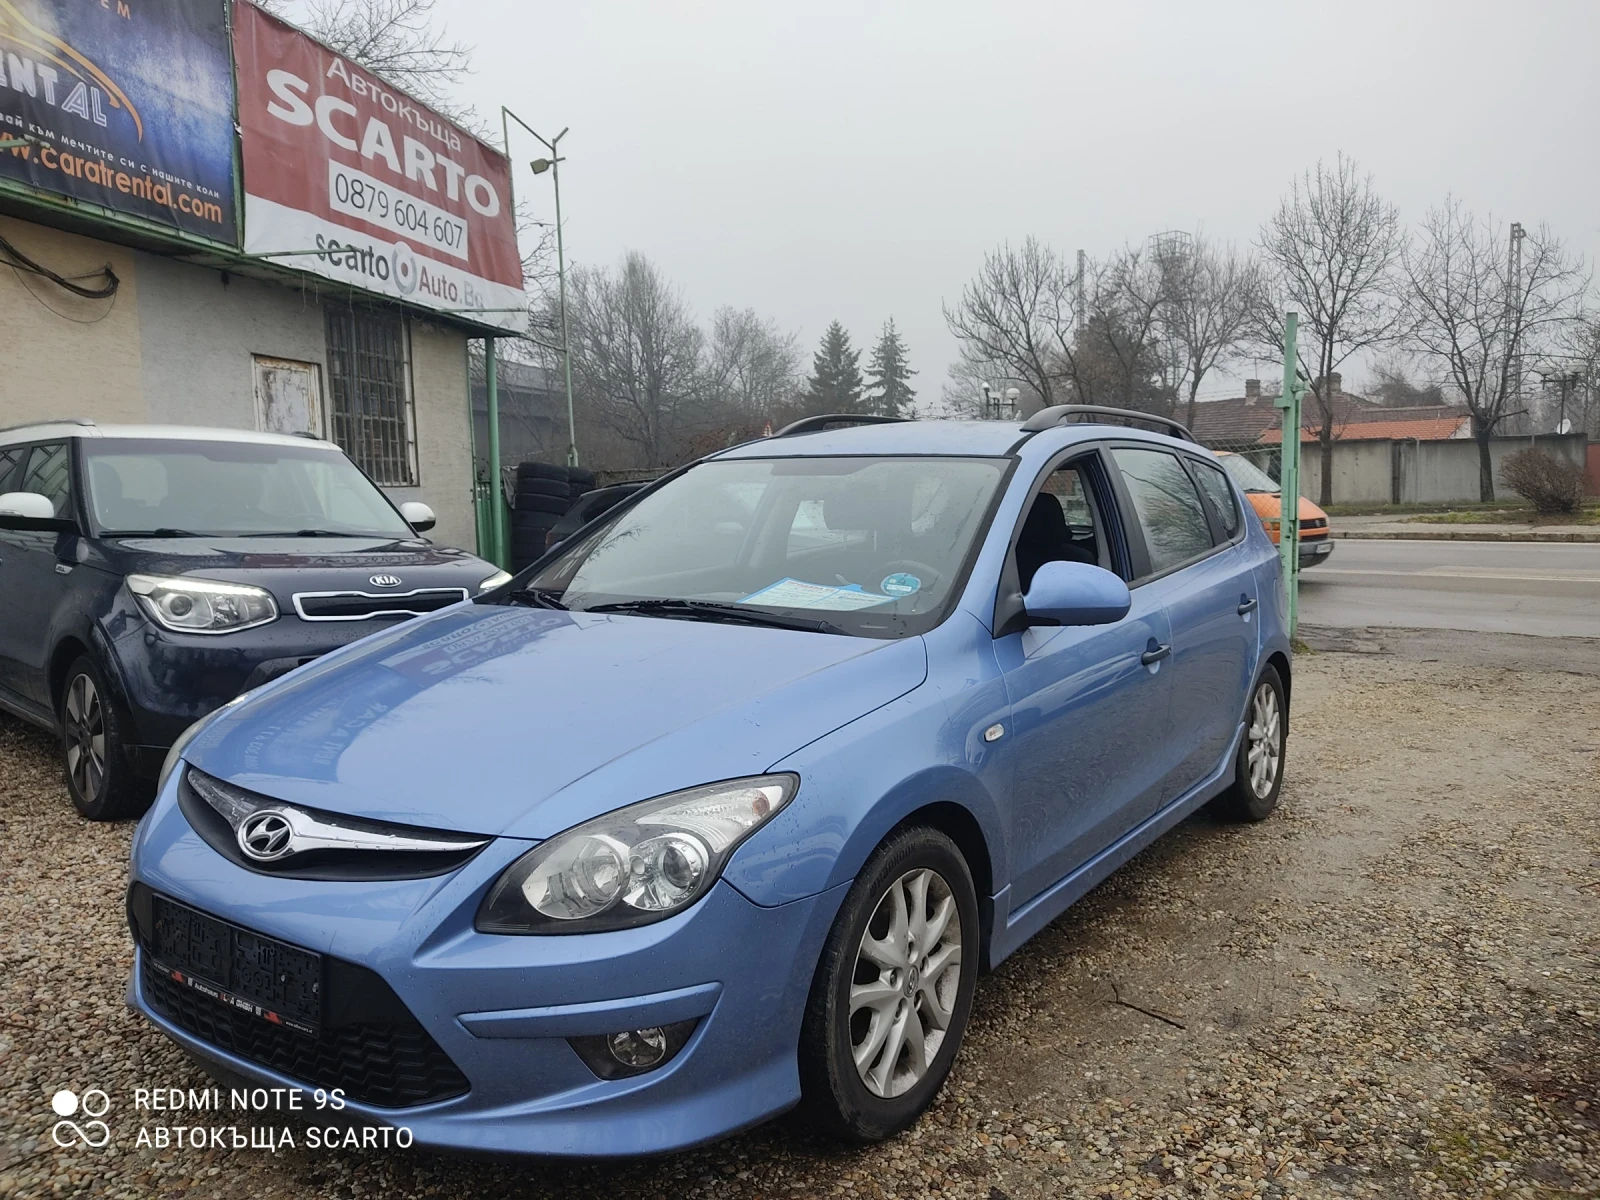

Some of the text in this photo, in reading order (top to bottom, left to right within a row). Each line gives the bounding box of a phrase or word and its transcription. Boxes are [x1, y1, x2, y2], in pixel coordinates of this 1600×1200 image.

[28, 123, 55, 140] към
[61, 134, 115, 161] мечтите
[119, 155, 136, 169] си
[152, 167, 193, 190] нашите
[196, 183, 221, 200] коли
[266, 68, 501, 218] SCARTO
[335, 173, 463, 250] 0879 604 607
[315, 233, 390, 281] scarto
[374, 574, 398, 585] KIA
